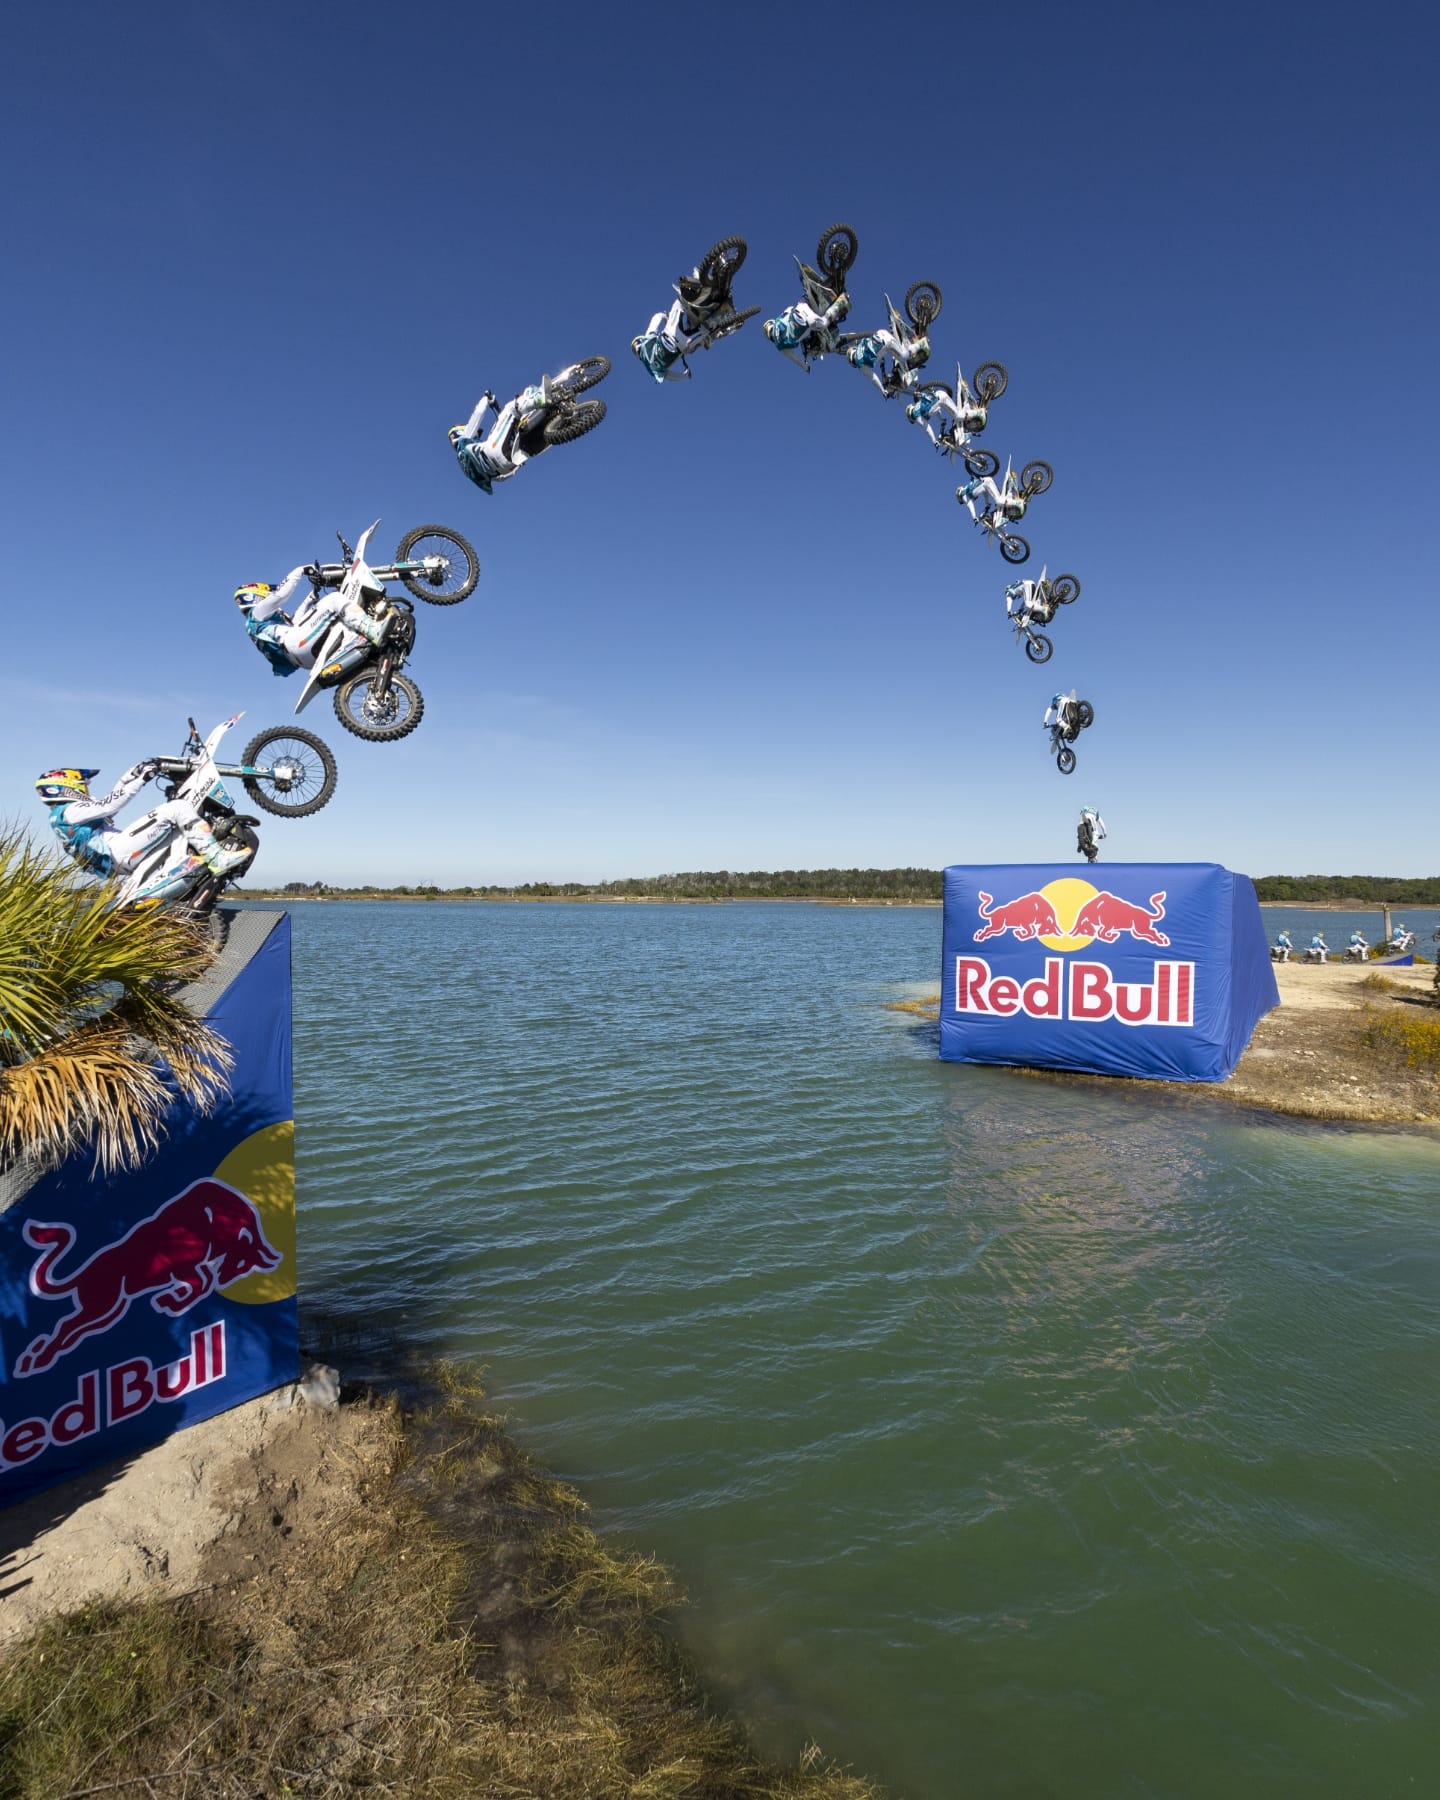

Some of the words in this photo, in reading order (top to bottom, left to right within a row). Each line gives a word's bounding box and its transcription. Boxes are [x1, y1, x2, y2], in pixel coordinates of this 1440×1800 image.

[956, 956, 1063, 1019] Red
[1068, 960, 1196, 1027] Bull
[0, 1368, 101, 1474] ed
[106, 1319, 227, 1427] Bull
